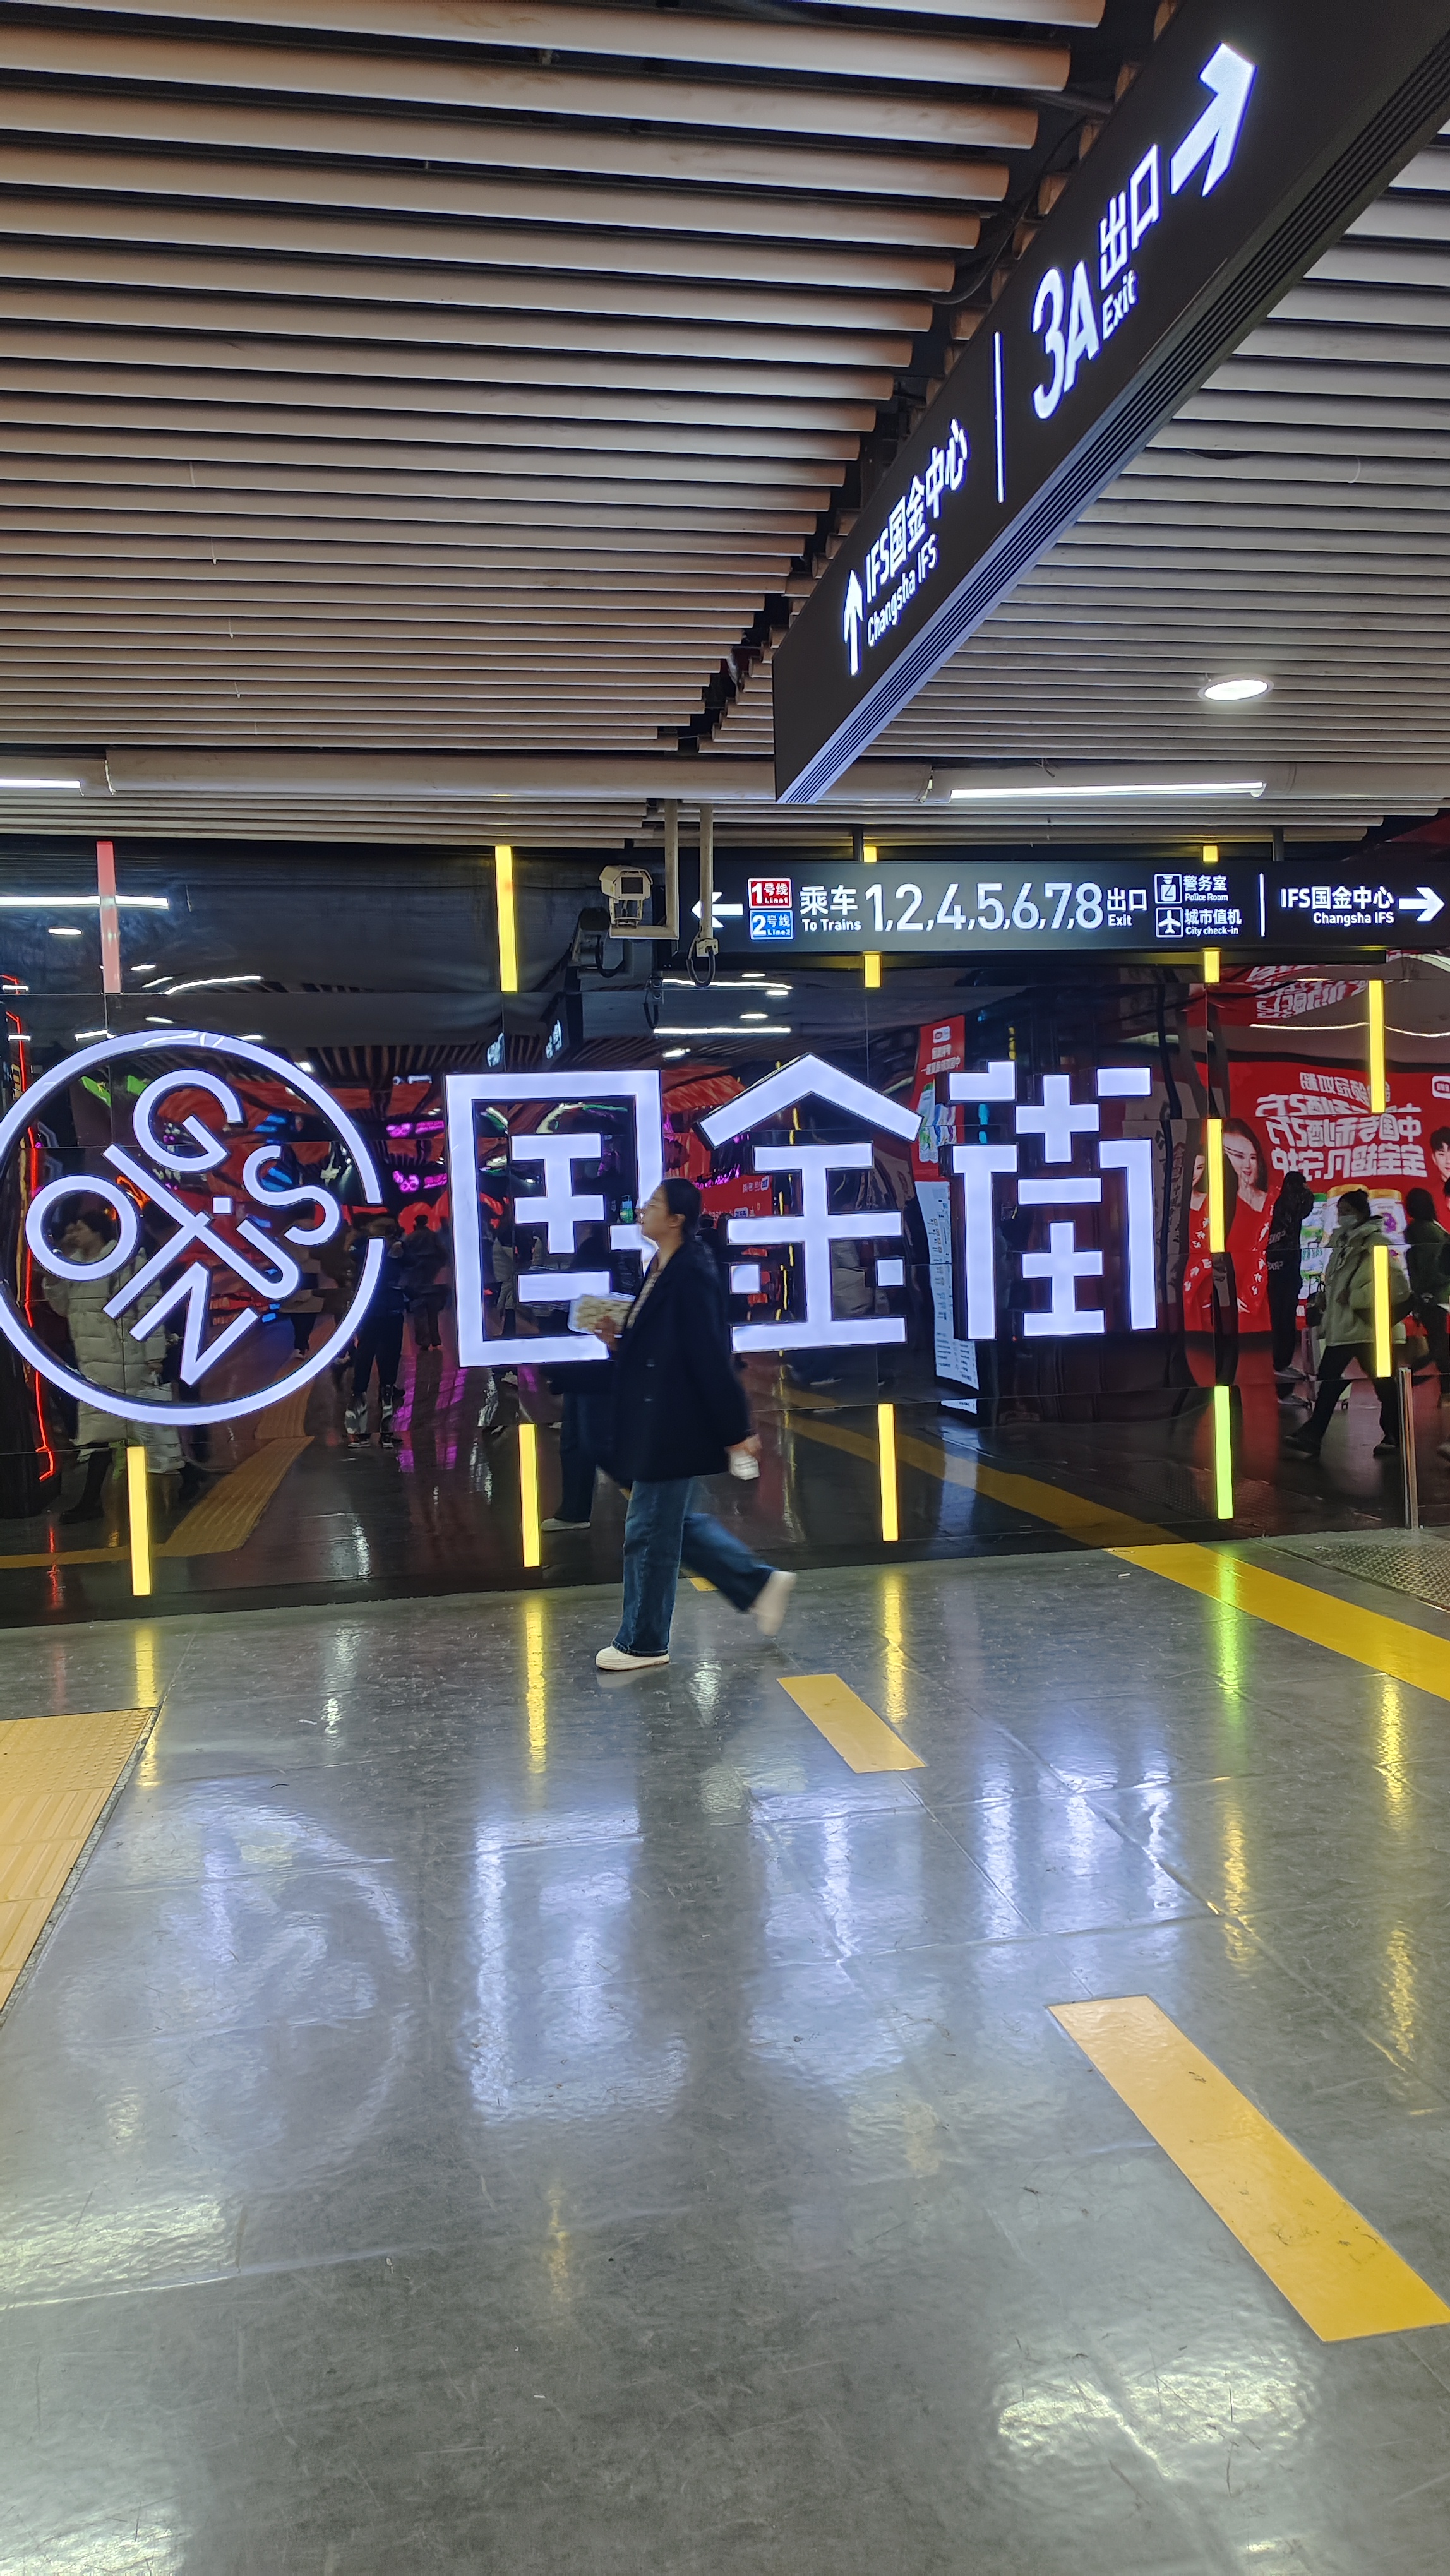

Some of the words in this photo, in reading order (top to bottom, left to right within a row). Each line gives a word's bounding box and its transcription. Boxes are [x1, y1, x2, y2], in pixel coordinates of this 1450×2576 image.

[1099, 143, 1158, 290] 出口
[1101, 269, 1137, 340] Exit
[1033, 259, 1099, 420] 3A
[866, 417, 968, 603] IFS国金中心
[867, 569, 916, 647] Changsha
[918, 534, 937, 584] IFS
[752, 882, 788, 904] 1号线
[1183, 874, 1227, 891] 警务室
[800, 884, 858, 915] 乘车
[1107, 887, 1147, 912] 出口
[1184, 893, 1206, 902] Police
[1207, 893, 1229, 902] Room
[1281, 885, 1394, 910] IFS国金中心
[752, 914, 791, 936] 2号线
[801, 918, 818, 931] To
[820, 918, 862, 931] Trains
[1108, 914, 1132, 927] Exit
[1184, 908, 1242, 925] 城市值机
[1313, 911, 1372, 927] Changsha
[1374, 911, 1394, 924] IFS
[1185, 926, 1202, 937] City
[1203, 926, 1239, 935] check-in
[445, 1053, 1157, 1367] 国金街
